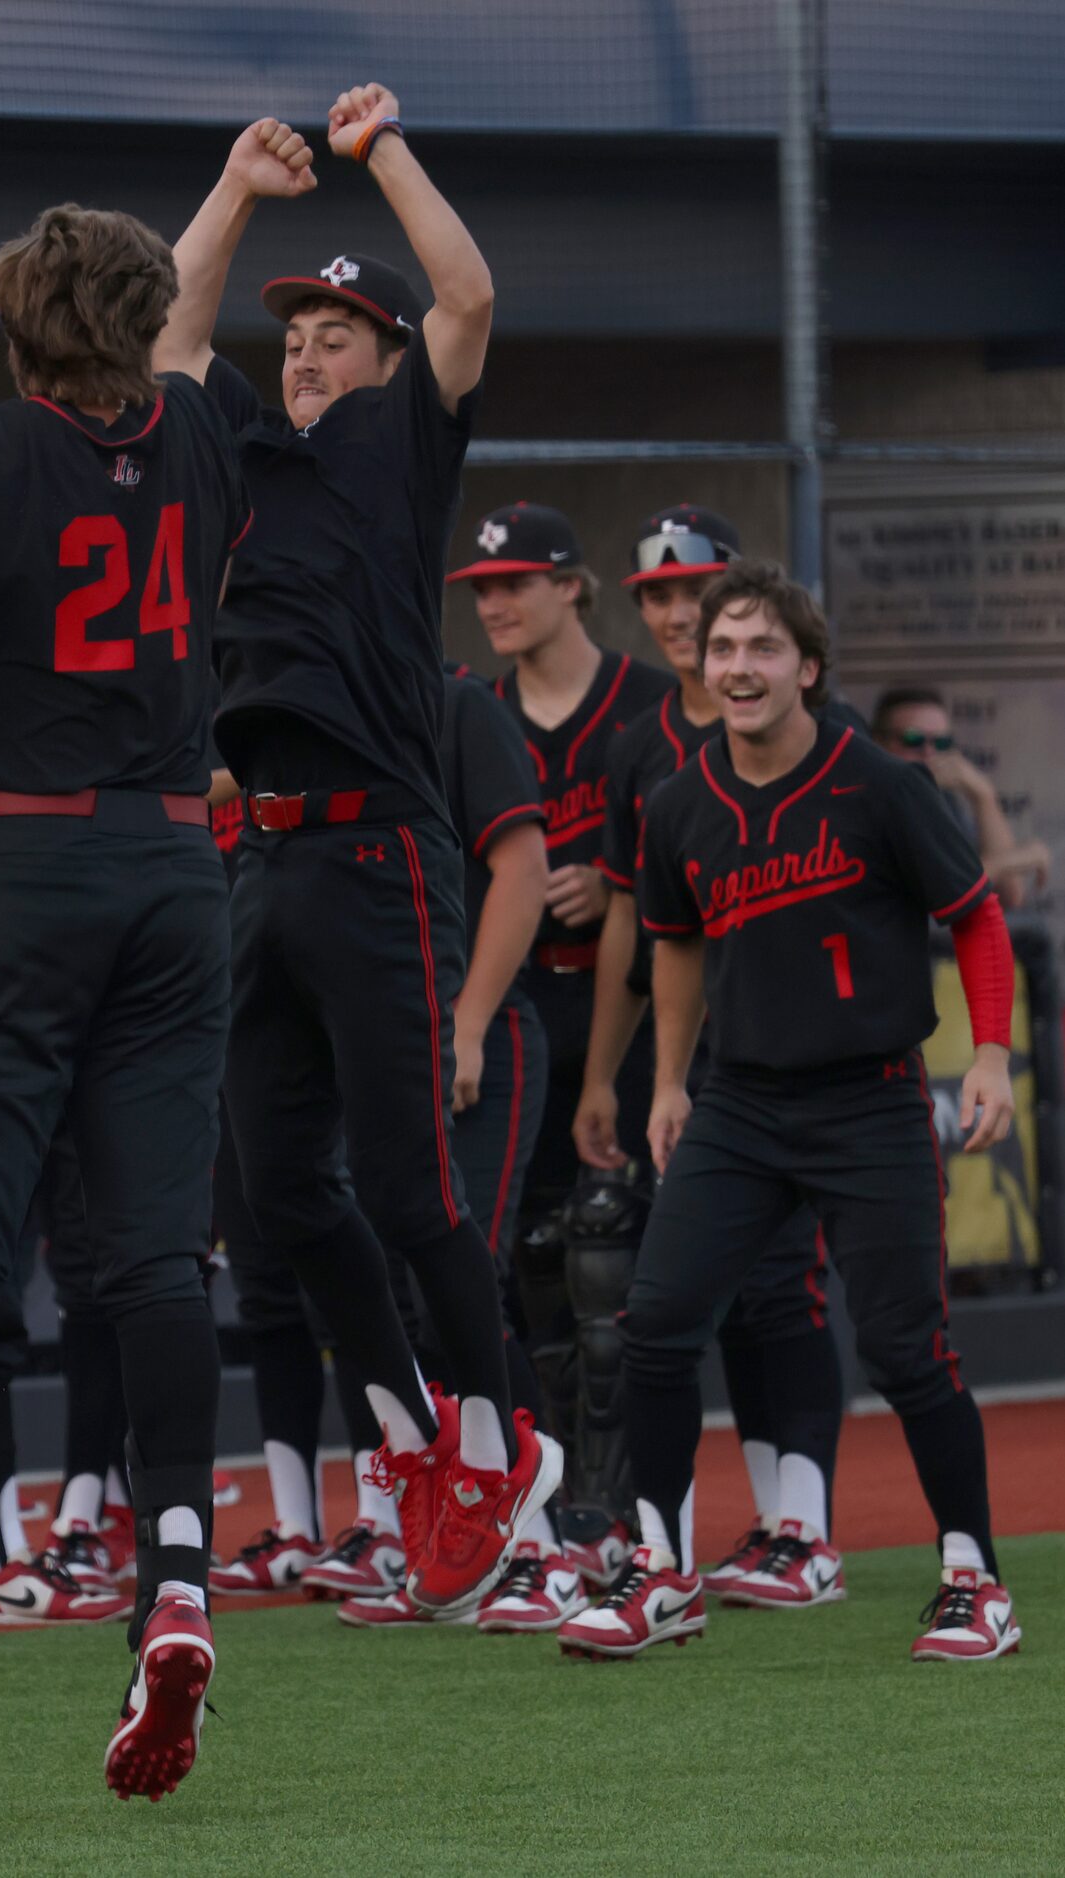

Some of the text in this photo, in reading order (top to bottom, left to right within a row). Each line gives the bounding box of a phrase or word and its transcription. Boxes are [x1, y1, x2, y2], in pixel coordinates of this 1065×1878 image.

[54, 502, 191, 673] 24
[685, 817, 854, 930] Leopards
[822, 933, 856, 1000] 1
